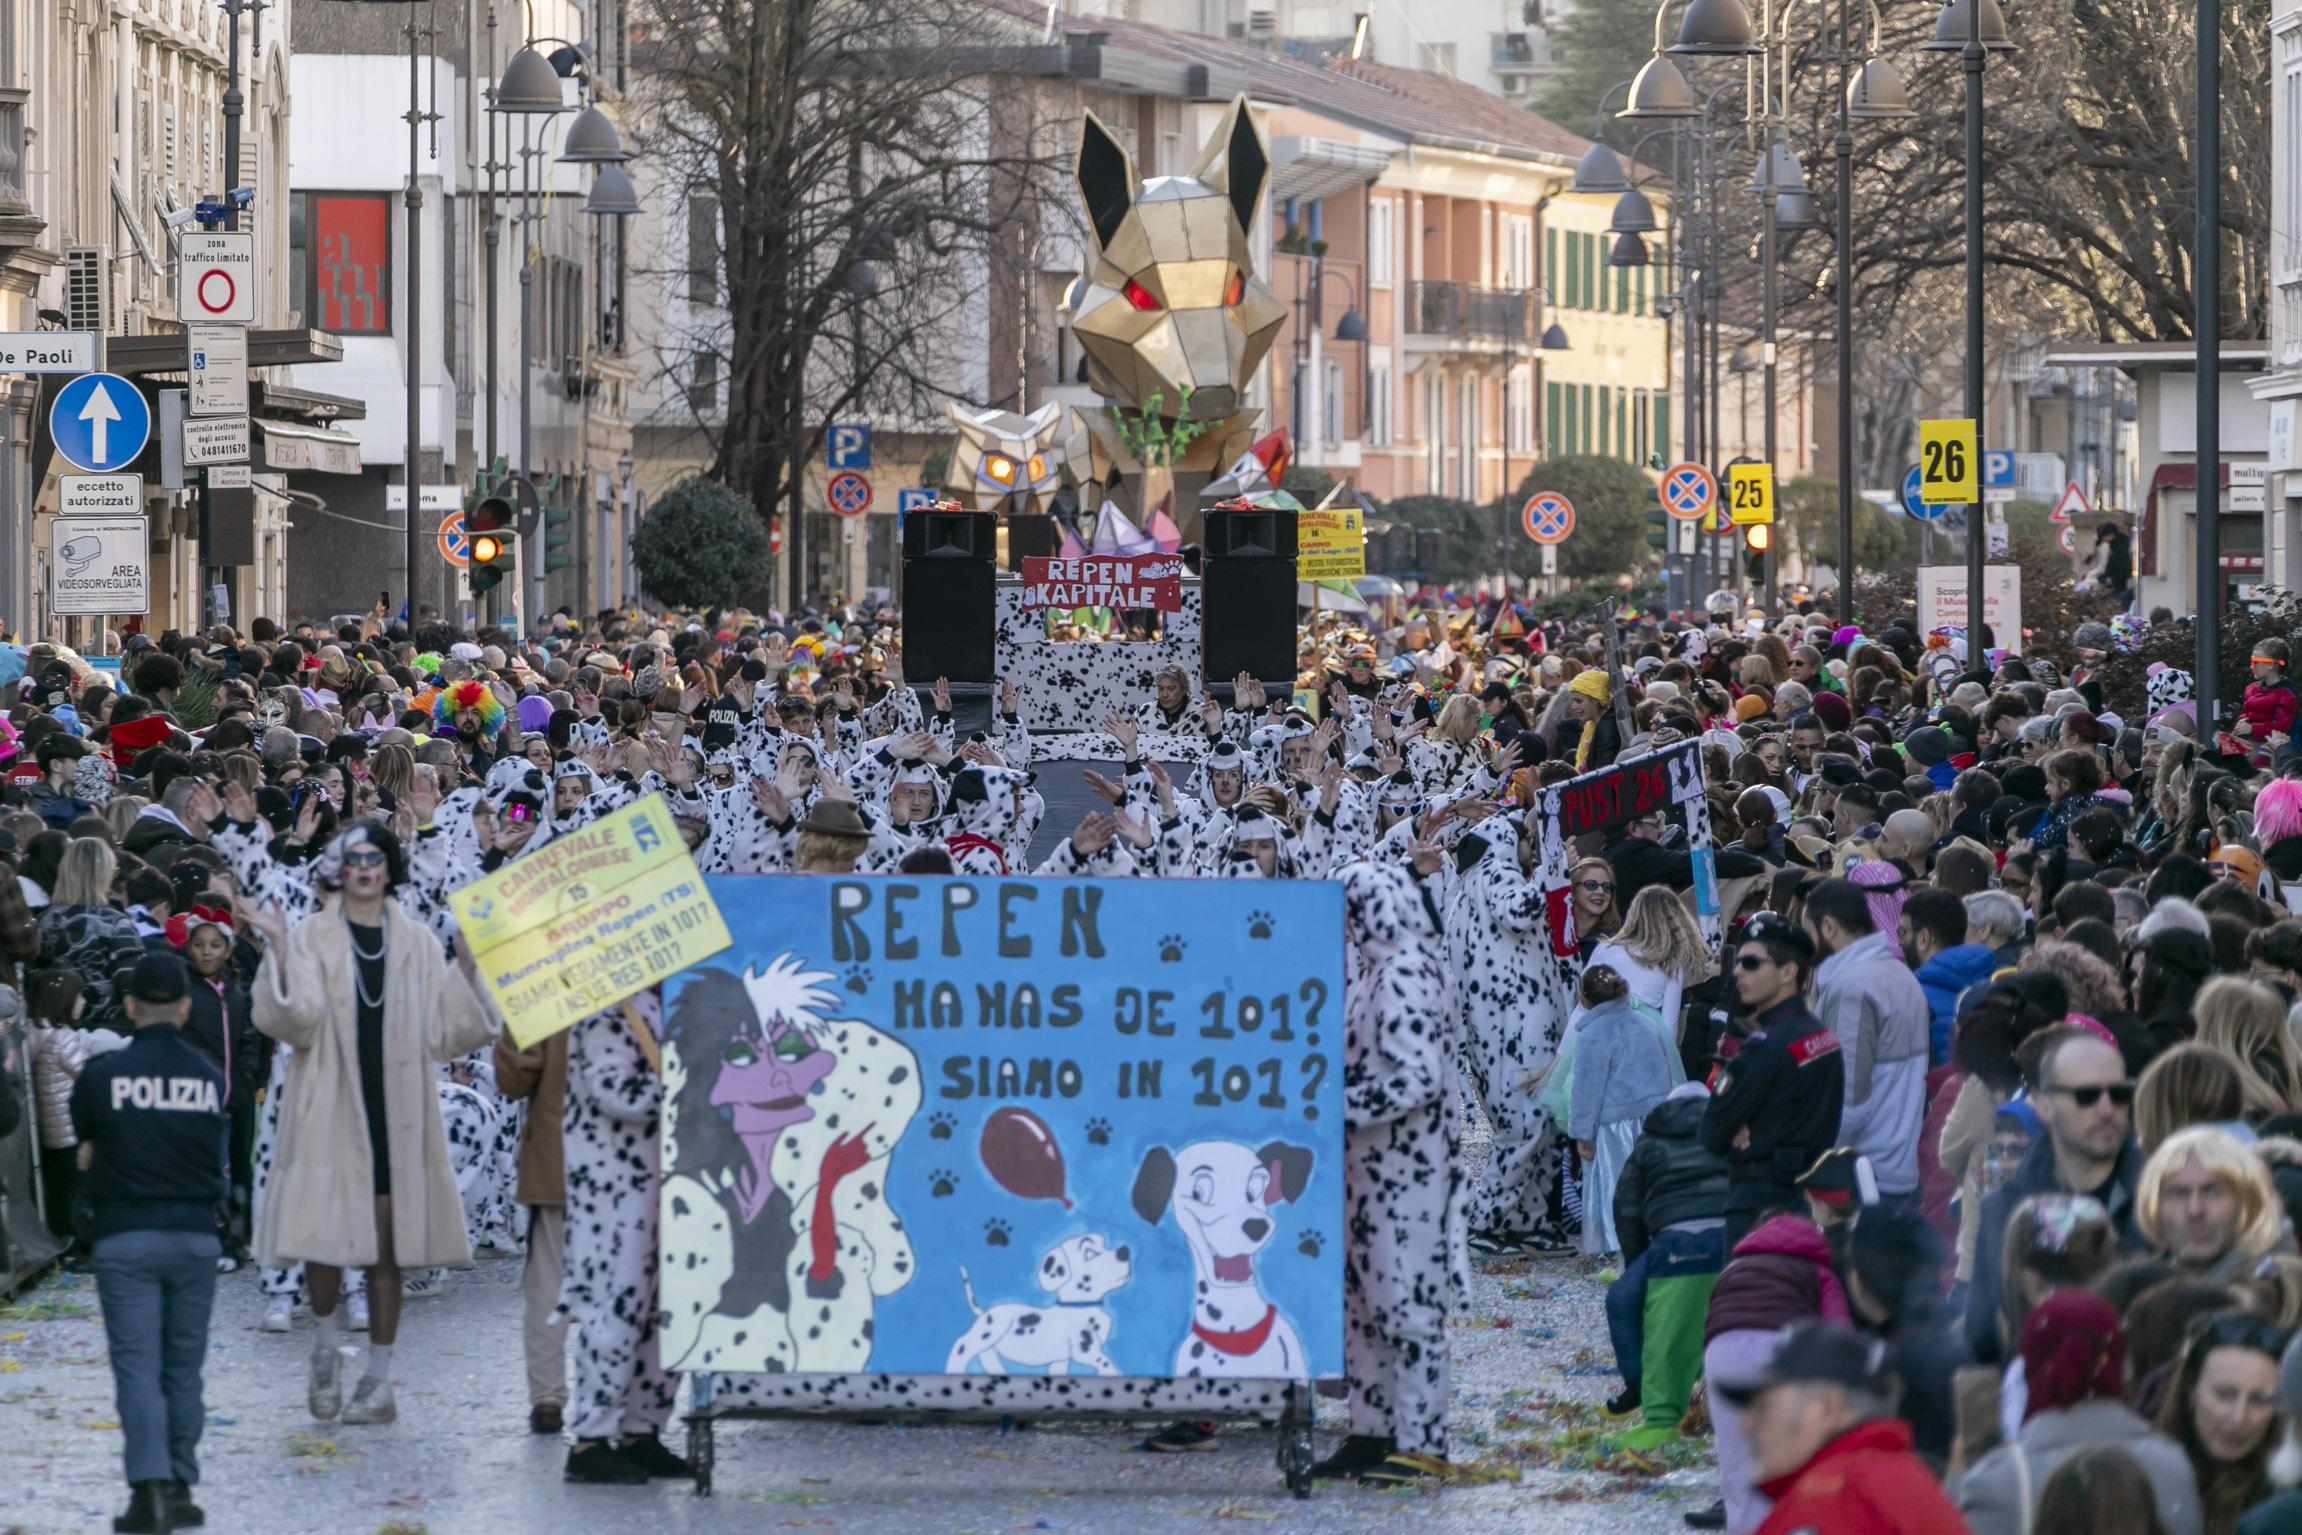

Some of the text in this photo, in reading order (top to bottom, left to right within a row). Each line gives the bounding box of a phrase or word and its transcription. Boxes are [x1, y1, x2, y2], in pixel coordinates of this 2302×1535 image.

[207, 240, 226, 248] zona
[184, 252, 250, 262] traffico limitato
[0, 349, 72, 364] e Paoli
[198, 434, 236, 443] degli accessi
[201, 443, 246, 456] 0481411670
[835, 428, 863, 465] P
[1925, 440, 1965, 483] 26
[1986, 453, 2009, 483] P
[77, 481, 124, 491] eccetto
[1735, 480, 1763, 508] 25
[68, 496, 133, 506] autorizzati
[1300, 541, 1331, 549] CARRO
[111, 565, 141, 577] AREA
[1048, 560, 1133, 584] REPEN
[57, 578, 142, 590] VIDEOSORVEGLIATA
[1037, 583, 1156, 608] KAPITALE
[1564, 761, 1665, 832] PUST 26
[498, 827, 616, 899] CARNEVALE
[567, 886, 589, 903] 15
[652, 920, 672, 945] IN
[672, 900, 710, 933] 101?
[830, 881, 1106, 962] REPEN
[644, 941, 684, 974] 101?
[1199, 977, 1329, 1048] 101?
[111, 1076, 220, 1114] POLIZIA
[940, 1053, 1328, 1120] SIAMO IN 101?
